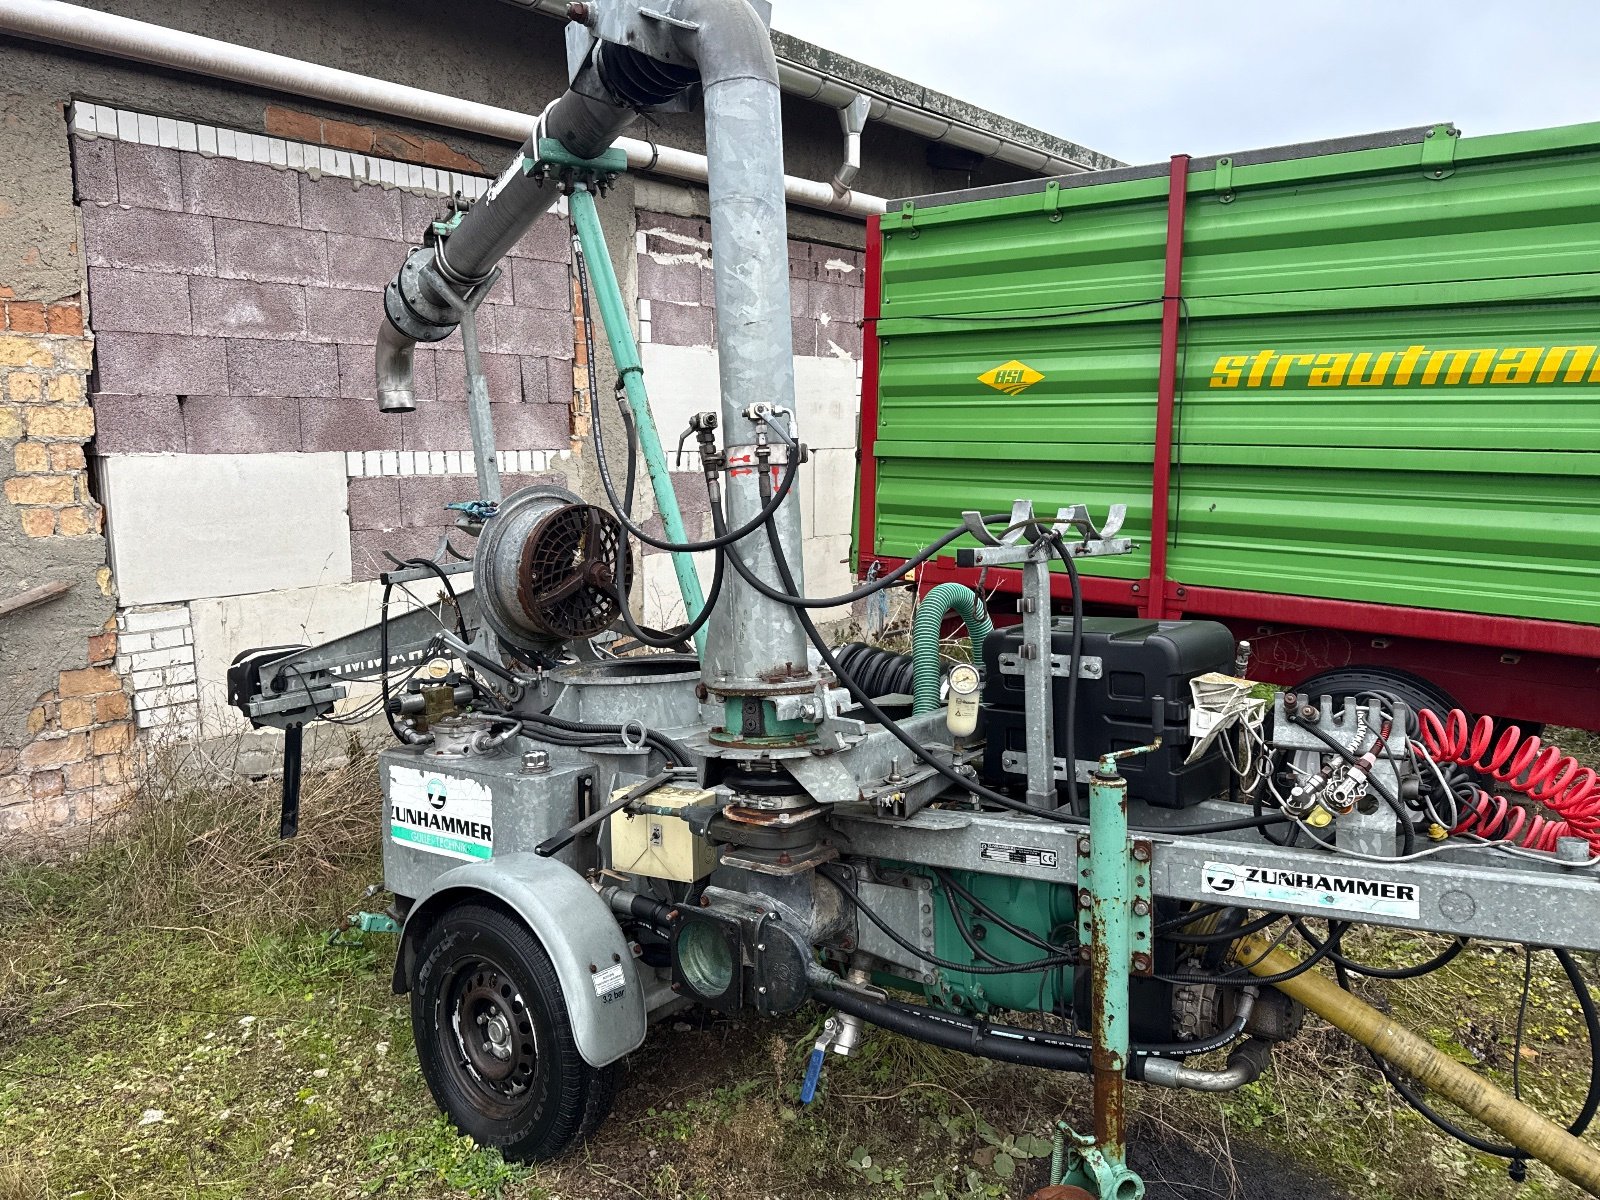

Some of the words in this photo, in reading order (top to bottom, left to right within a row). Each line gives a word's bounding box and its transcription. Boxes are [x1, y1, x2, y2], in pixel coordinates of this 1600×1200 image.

[994, 369, 1025, 384] BSL
[1246, 868, 1414, 901] ZUNHAMMER
[614, 989, 625, 999] bar
